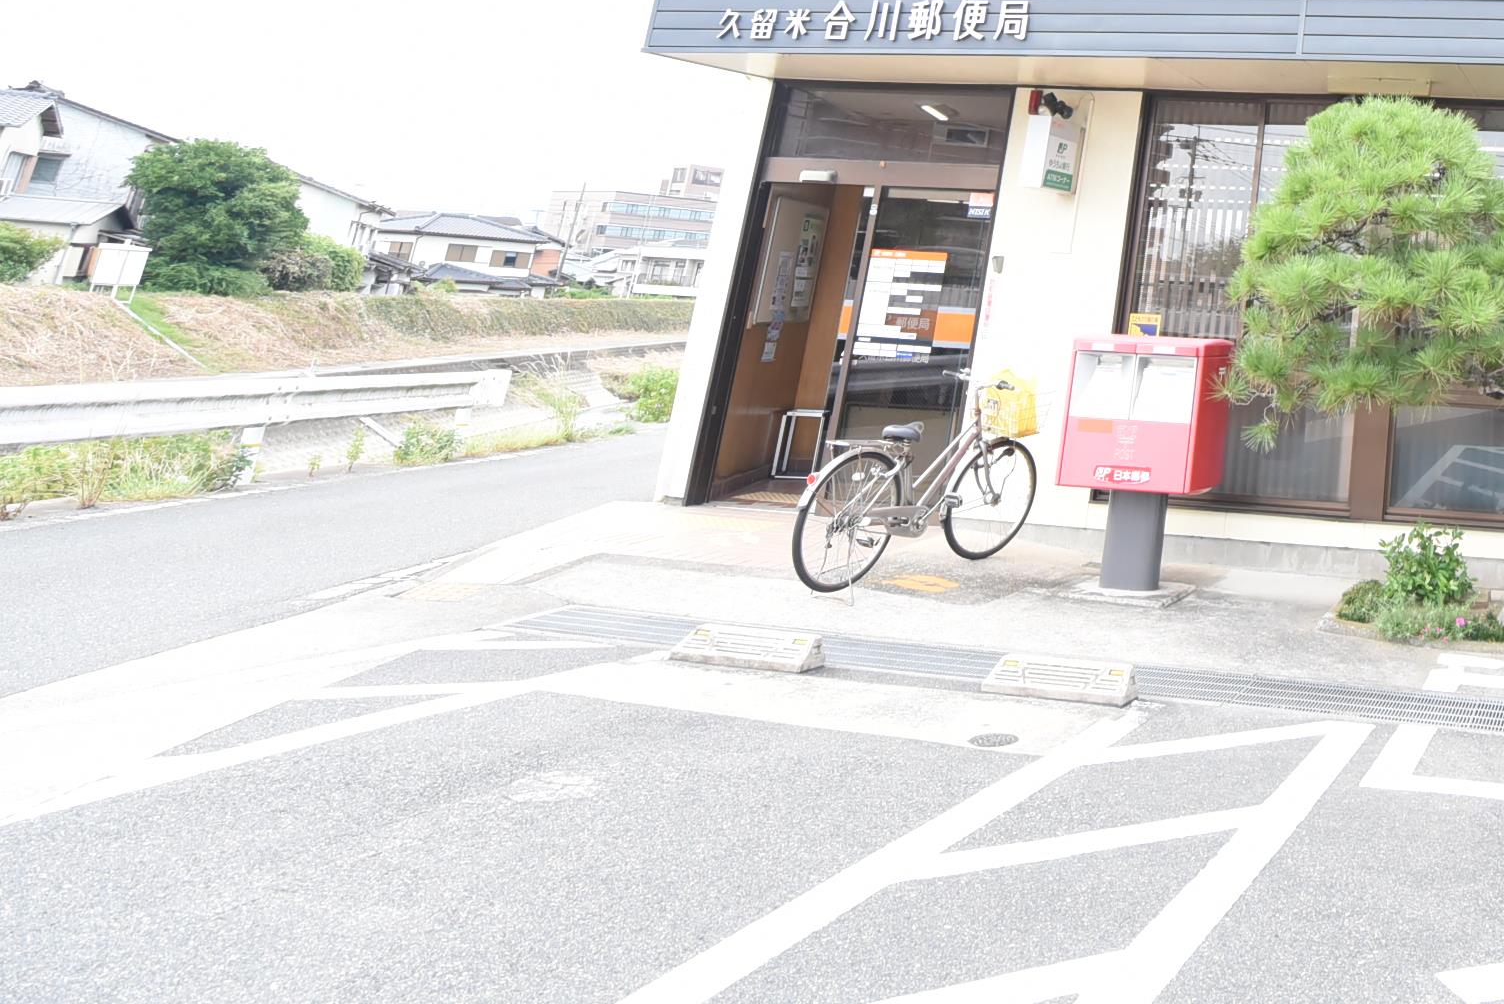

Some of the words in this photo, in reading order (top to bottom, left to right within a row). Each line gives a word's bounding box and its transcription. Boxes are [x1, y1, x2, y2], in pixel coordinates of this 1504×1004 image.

[717, 0, 1031, 42] 久留米合川郵便局
